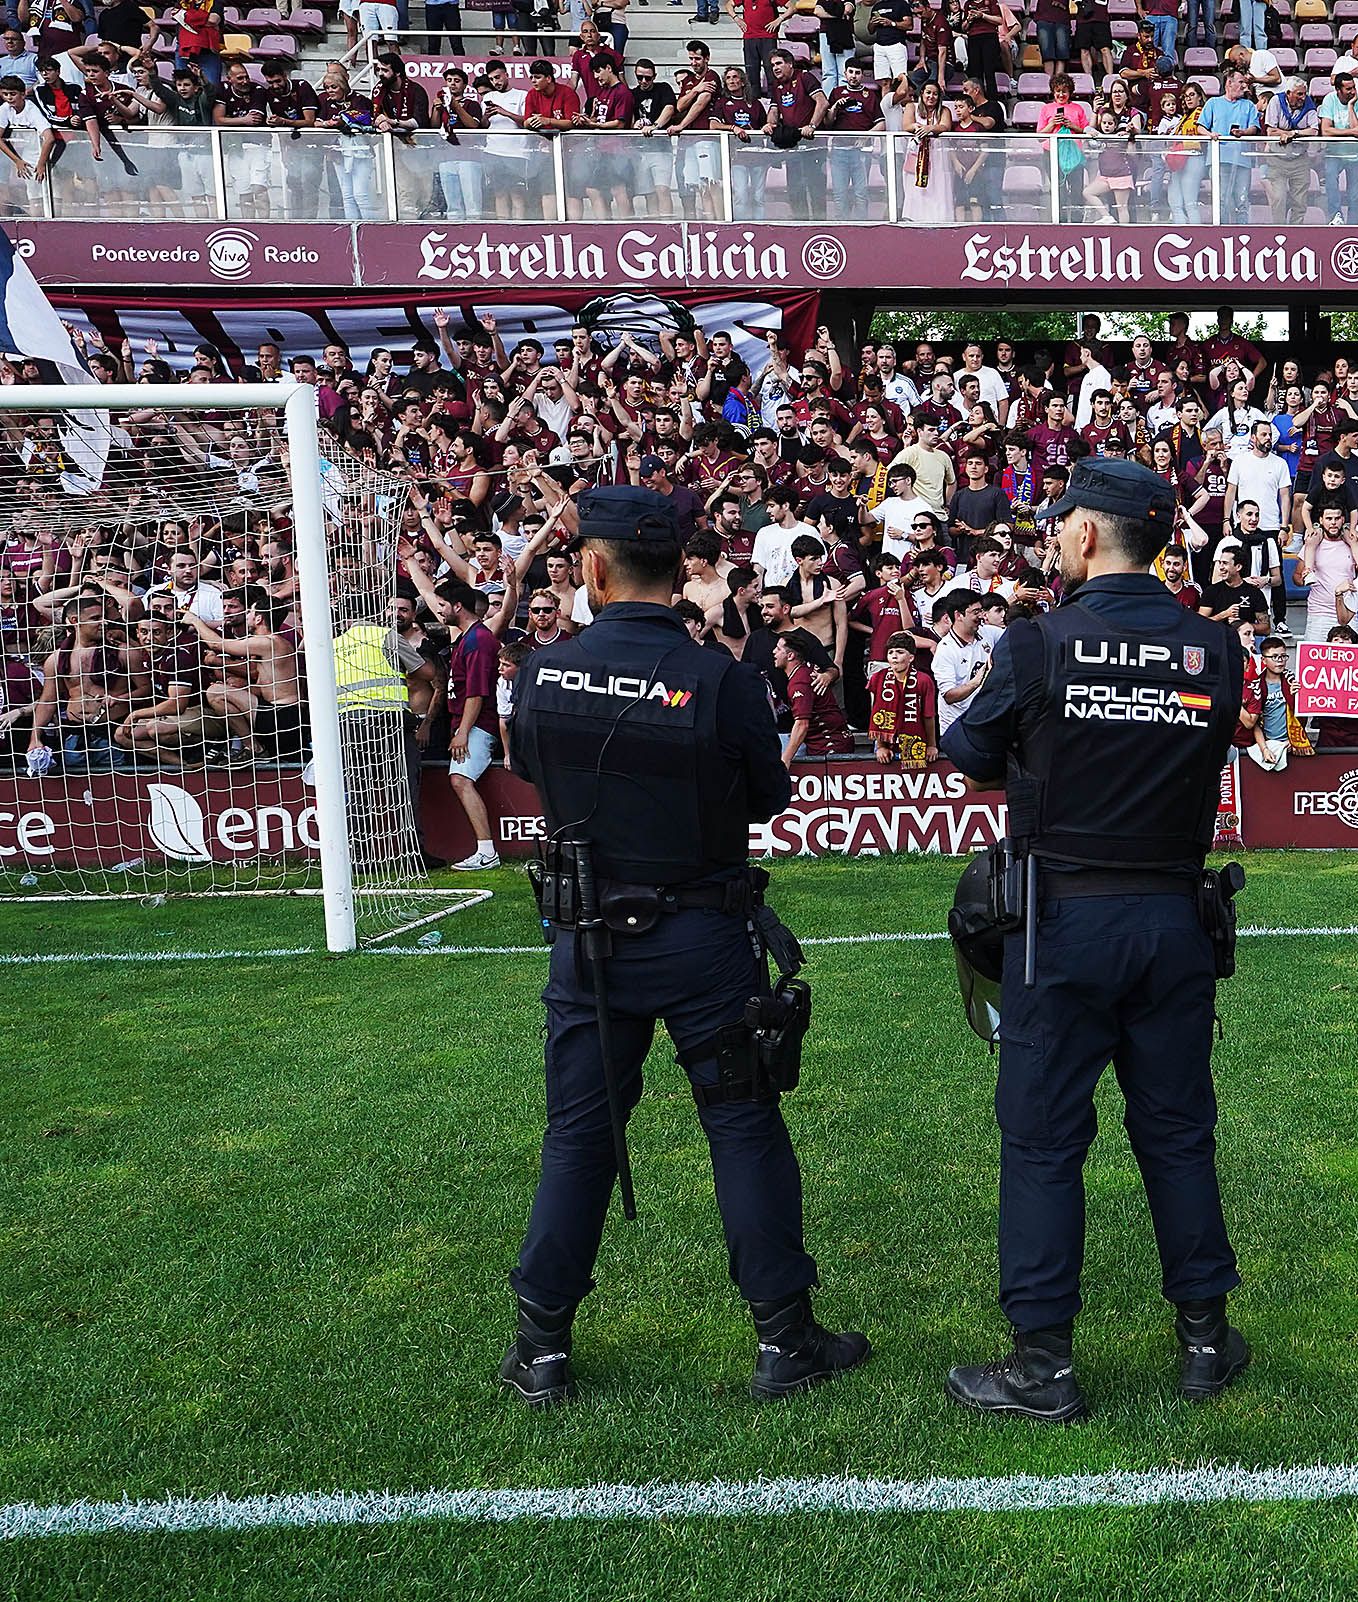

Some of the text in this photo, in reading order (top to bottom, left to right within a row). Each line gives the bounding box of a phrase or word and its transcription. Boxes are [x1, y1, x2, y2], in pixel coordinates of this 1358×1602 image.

[93, 245, 318, 262] Pontevedra Viva Radio
[418, 230, 789, 281] Estrella Galicia
[961, 233, 1319, 283] Estrella Galicia
[1075, 640, 1178, 669] U.I.P.
[1308, 647, 1355, 662] QUIERO
[536, 668, 669, 701] POLICIA
[1065, 685, 1183, 707] POLICIA
[1064, 702, 1210, 728] NACIONAL
[1307, 695, 1337, 709] POR
